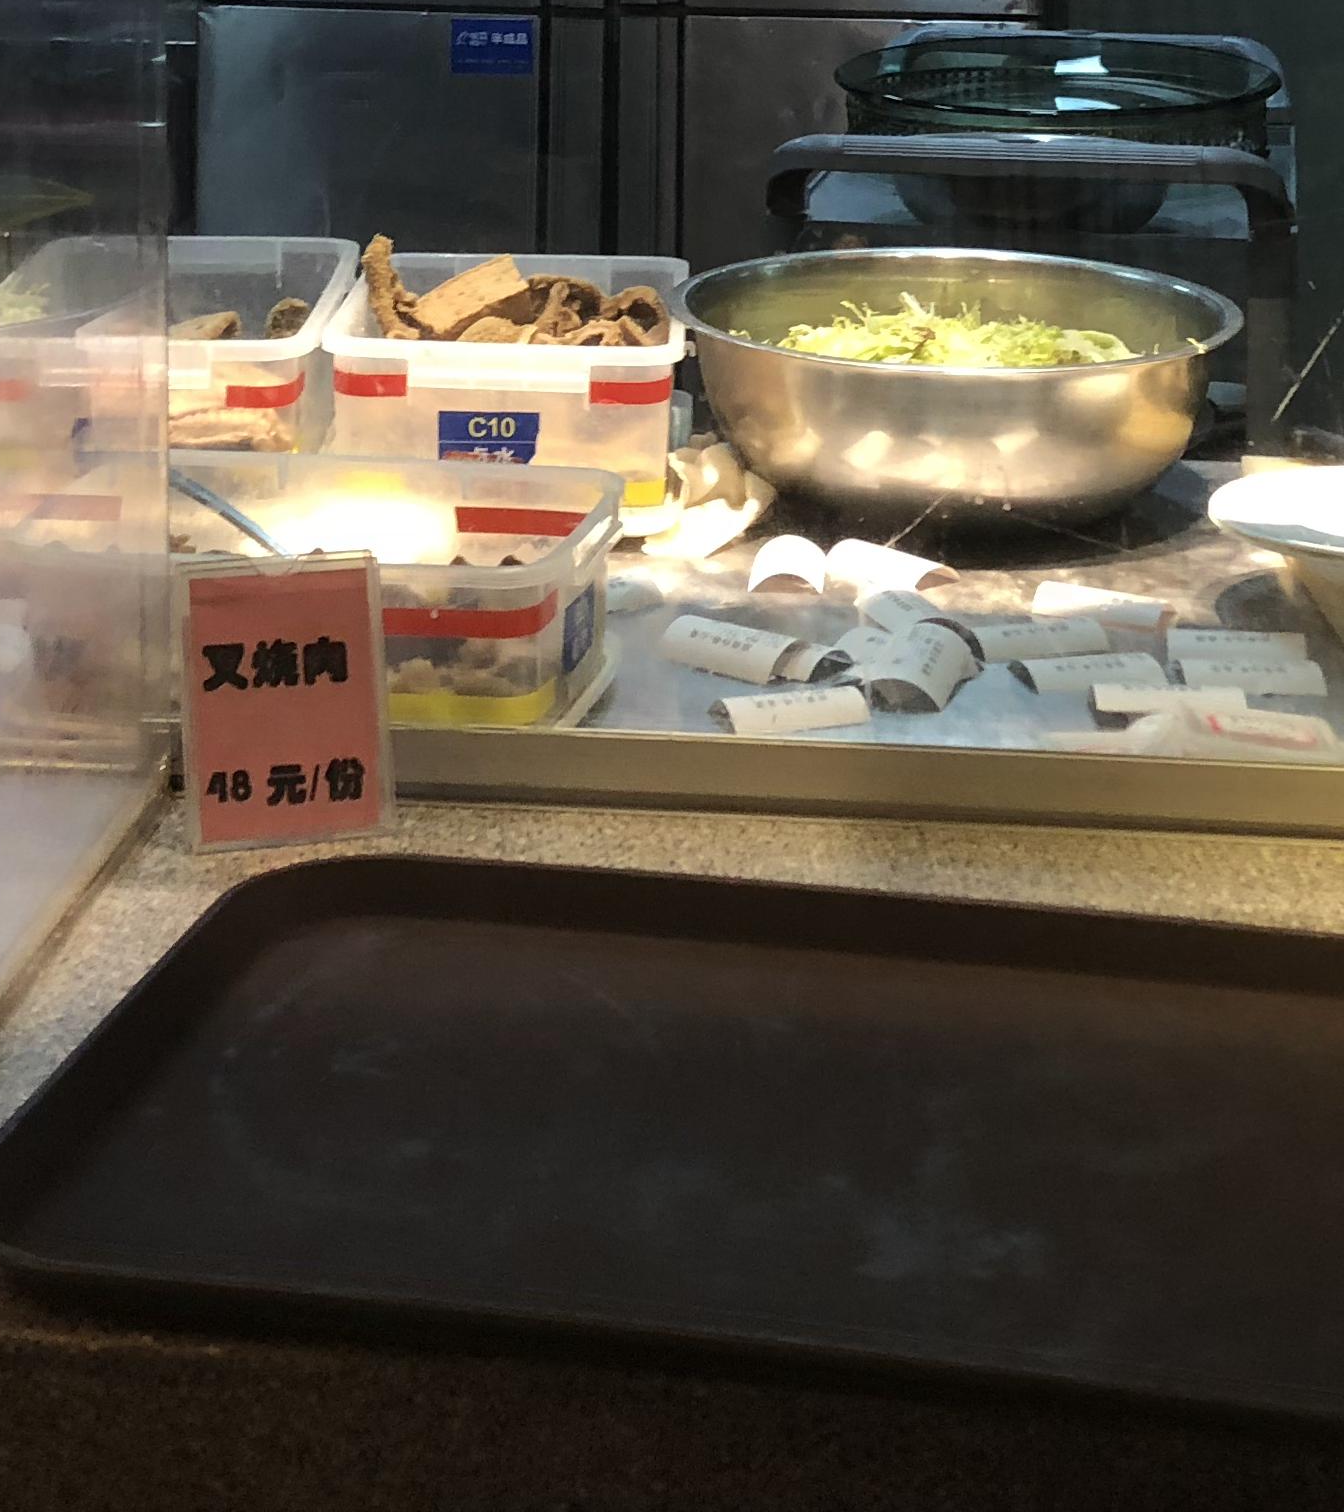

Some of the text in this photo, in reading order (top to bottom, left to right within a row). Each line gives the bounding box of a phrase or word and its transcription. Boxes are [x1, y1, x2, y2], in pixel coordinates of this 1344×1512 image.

[467, 415, 517, 438] C10
[202, 635, 349, 692] 叉烧肉
[207, 756, 366, 807] 48 元/份
